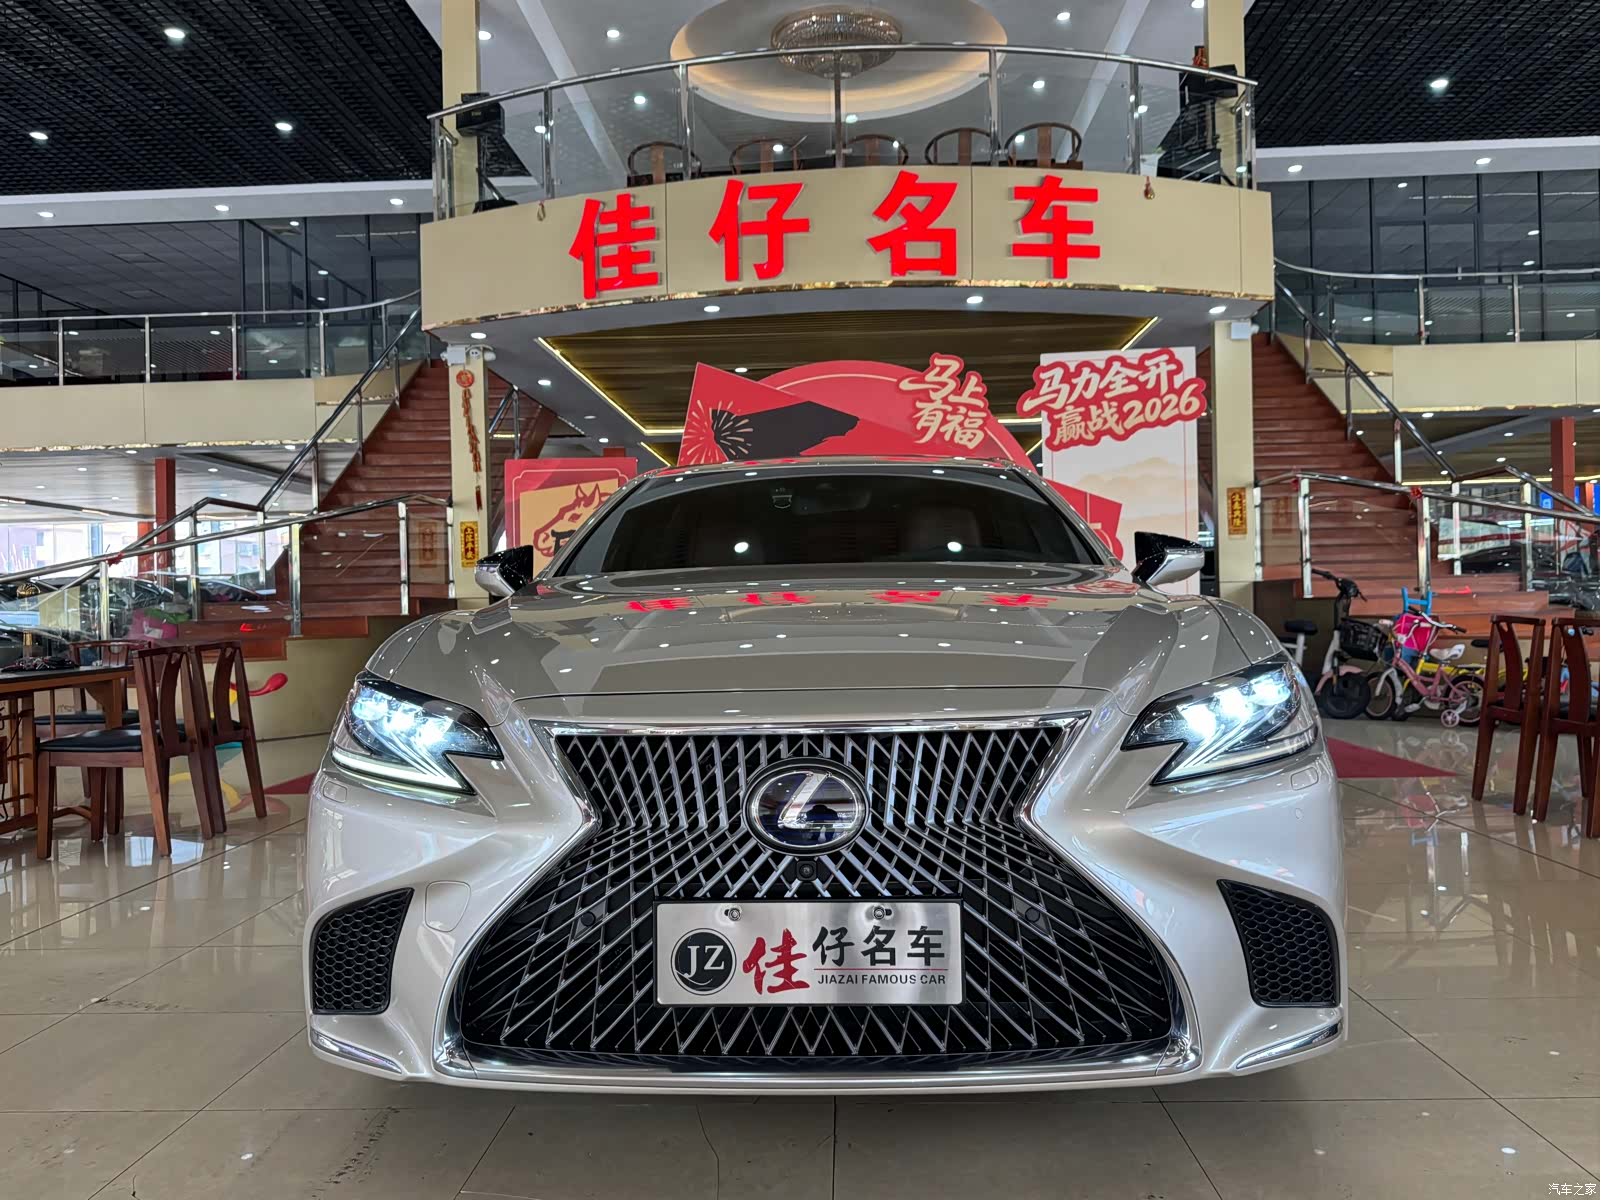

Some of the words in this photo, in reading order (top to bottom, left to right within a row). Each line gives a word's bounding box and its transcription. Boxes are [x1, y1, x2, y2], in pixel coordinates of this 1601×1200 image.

[568, 170, 1101, 299] 佳仔名车
[899, 358, 985, 408] 马上
[1023, 354, 1177, 410] 马力全开
[912, 400, 987, 449] 有福
[1053, 384, 1200, 446] 赢战2026
[687, 945, 724, 979] JZ
[818, 974, 858, 985] JIAZAI
[861, 974, 917, 985] FAMOUS
[920, 974, 946, 985] CAR
